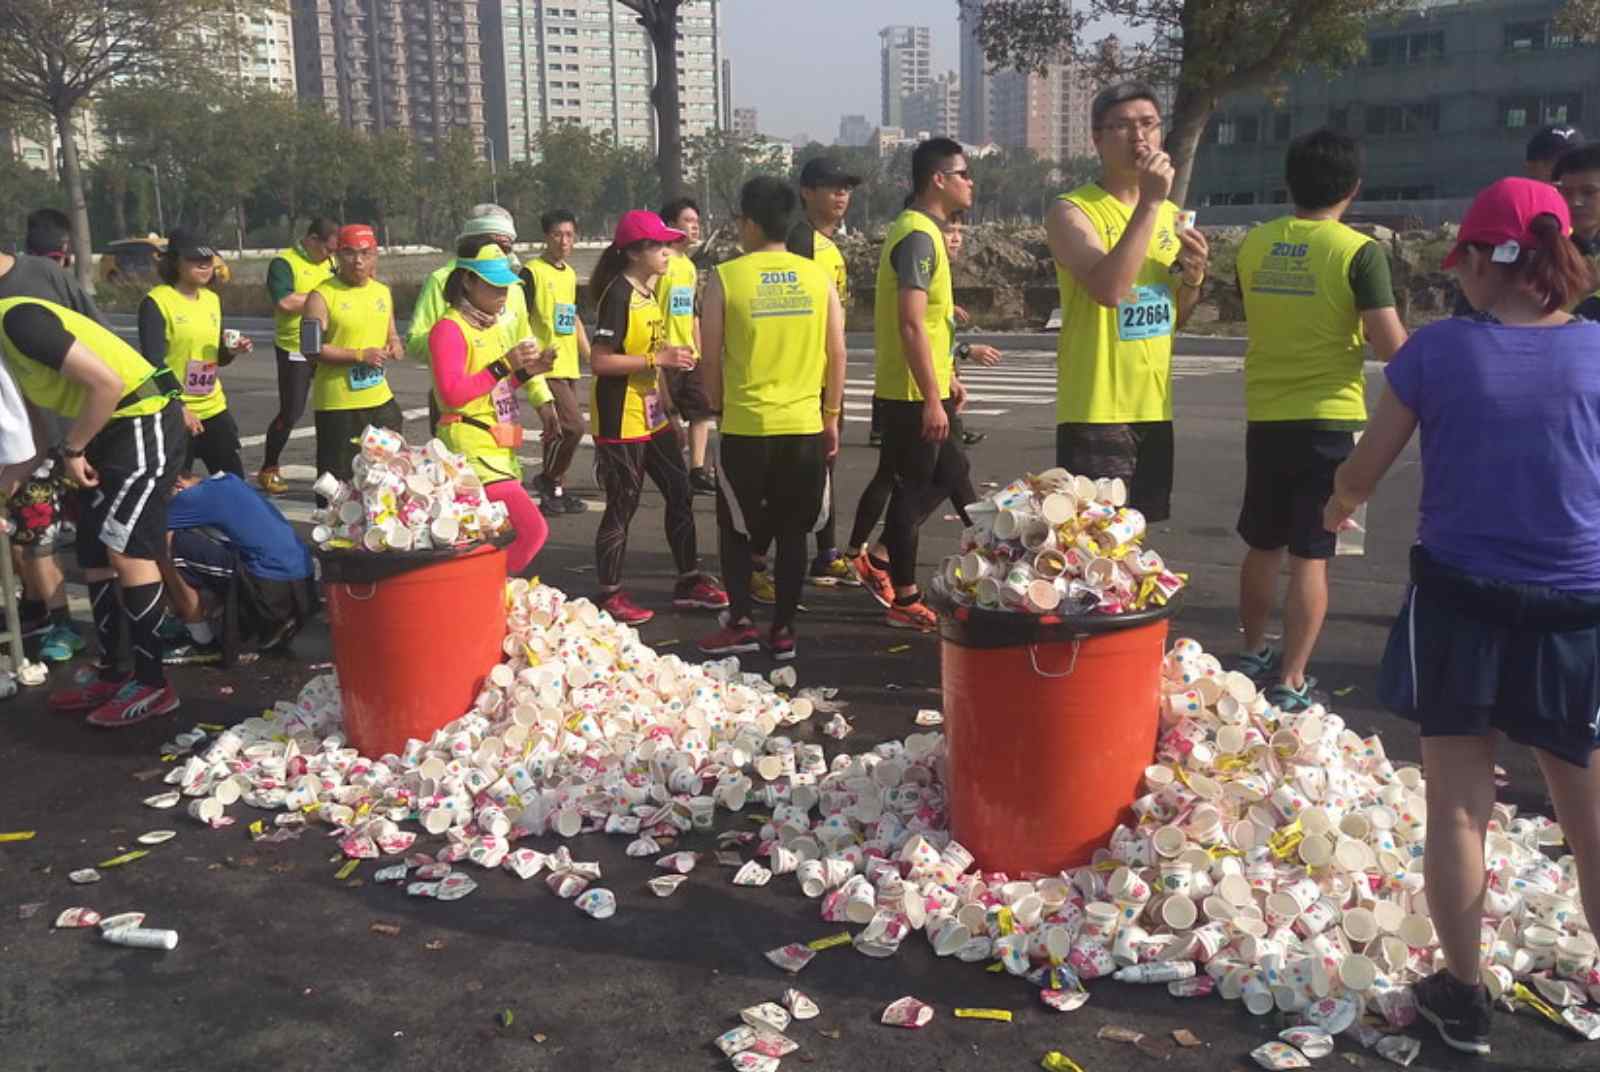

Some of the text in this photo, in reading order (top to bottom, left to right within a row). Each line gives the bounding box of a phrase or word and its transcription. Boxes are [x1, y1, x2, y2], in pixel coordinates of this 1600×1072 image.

[1270, 242, 1309, 256] 2016
[760, 271, 798, 284] 2016
[1123, 303, 1170, 328] 22664
